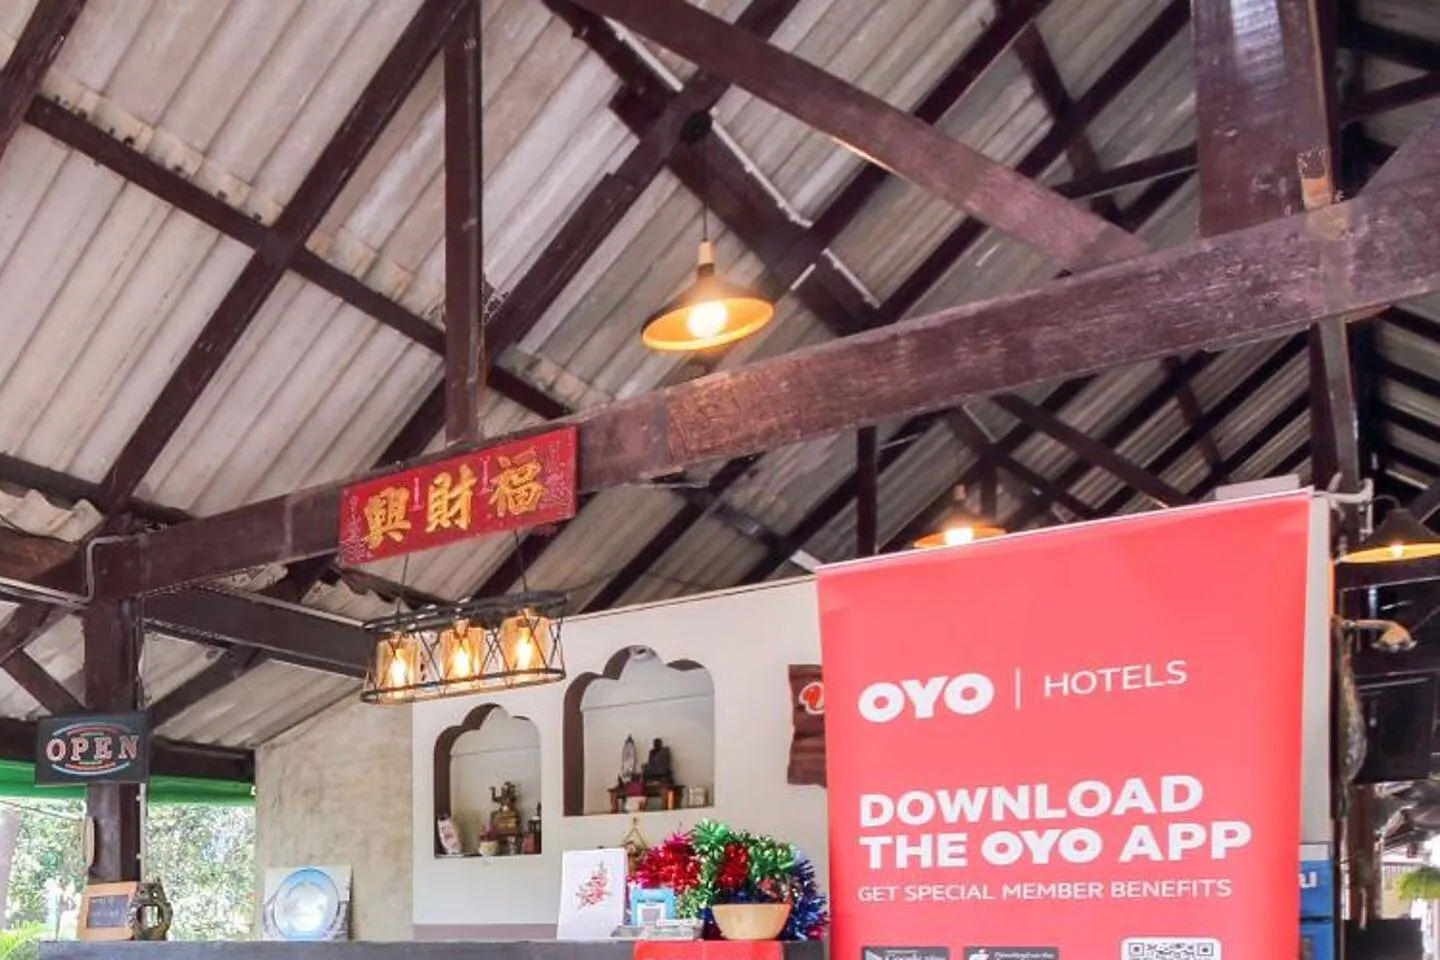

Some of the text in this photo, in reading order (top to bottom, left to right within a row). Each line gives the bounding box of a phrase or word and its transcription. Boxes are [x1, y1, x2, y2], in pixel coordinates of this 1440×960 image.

[858, 660, 1188, 722] OYO HOTELS
[46, 735, 139, 762] OPEN
[860, 775, 1203, 827] DOWNLOAD
[859, 821, 1252, 869] THE OYO APP
[858, 879, 1233, 902] GET SPECIAL MEMBER BENEFITS
